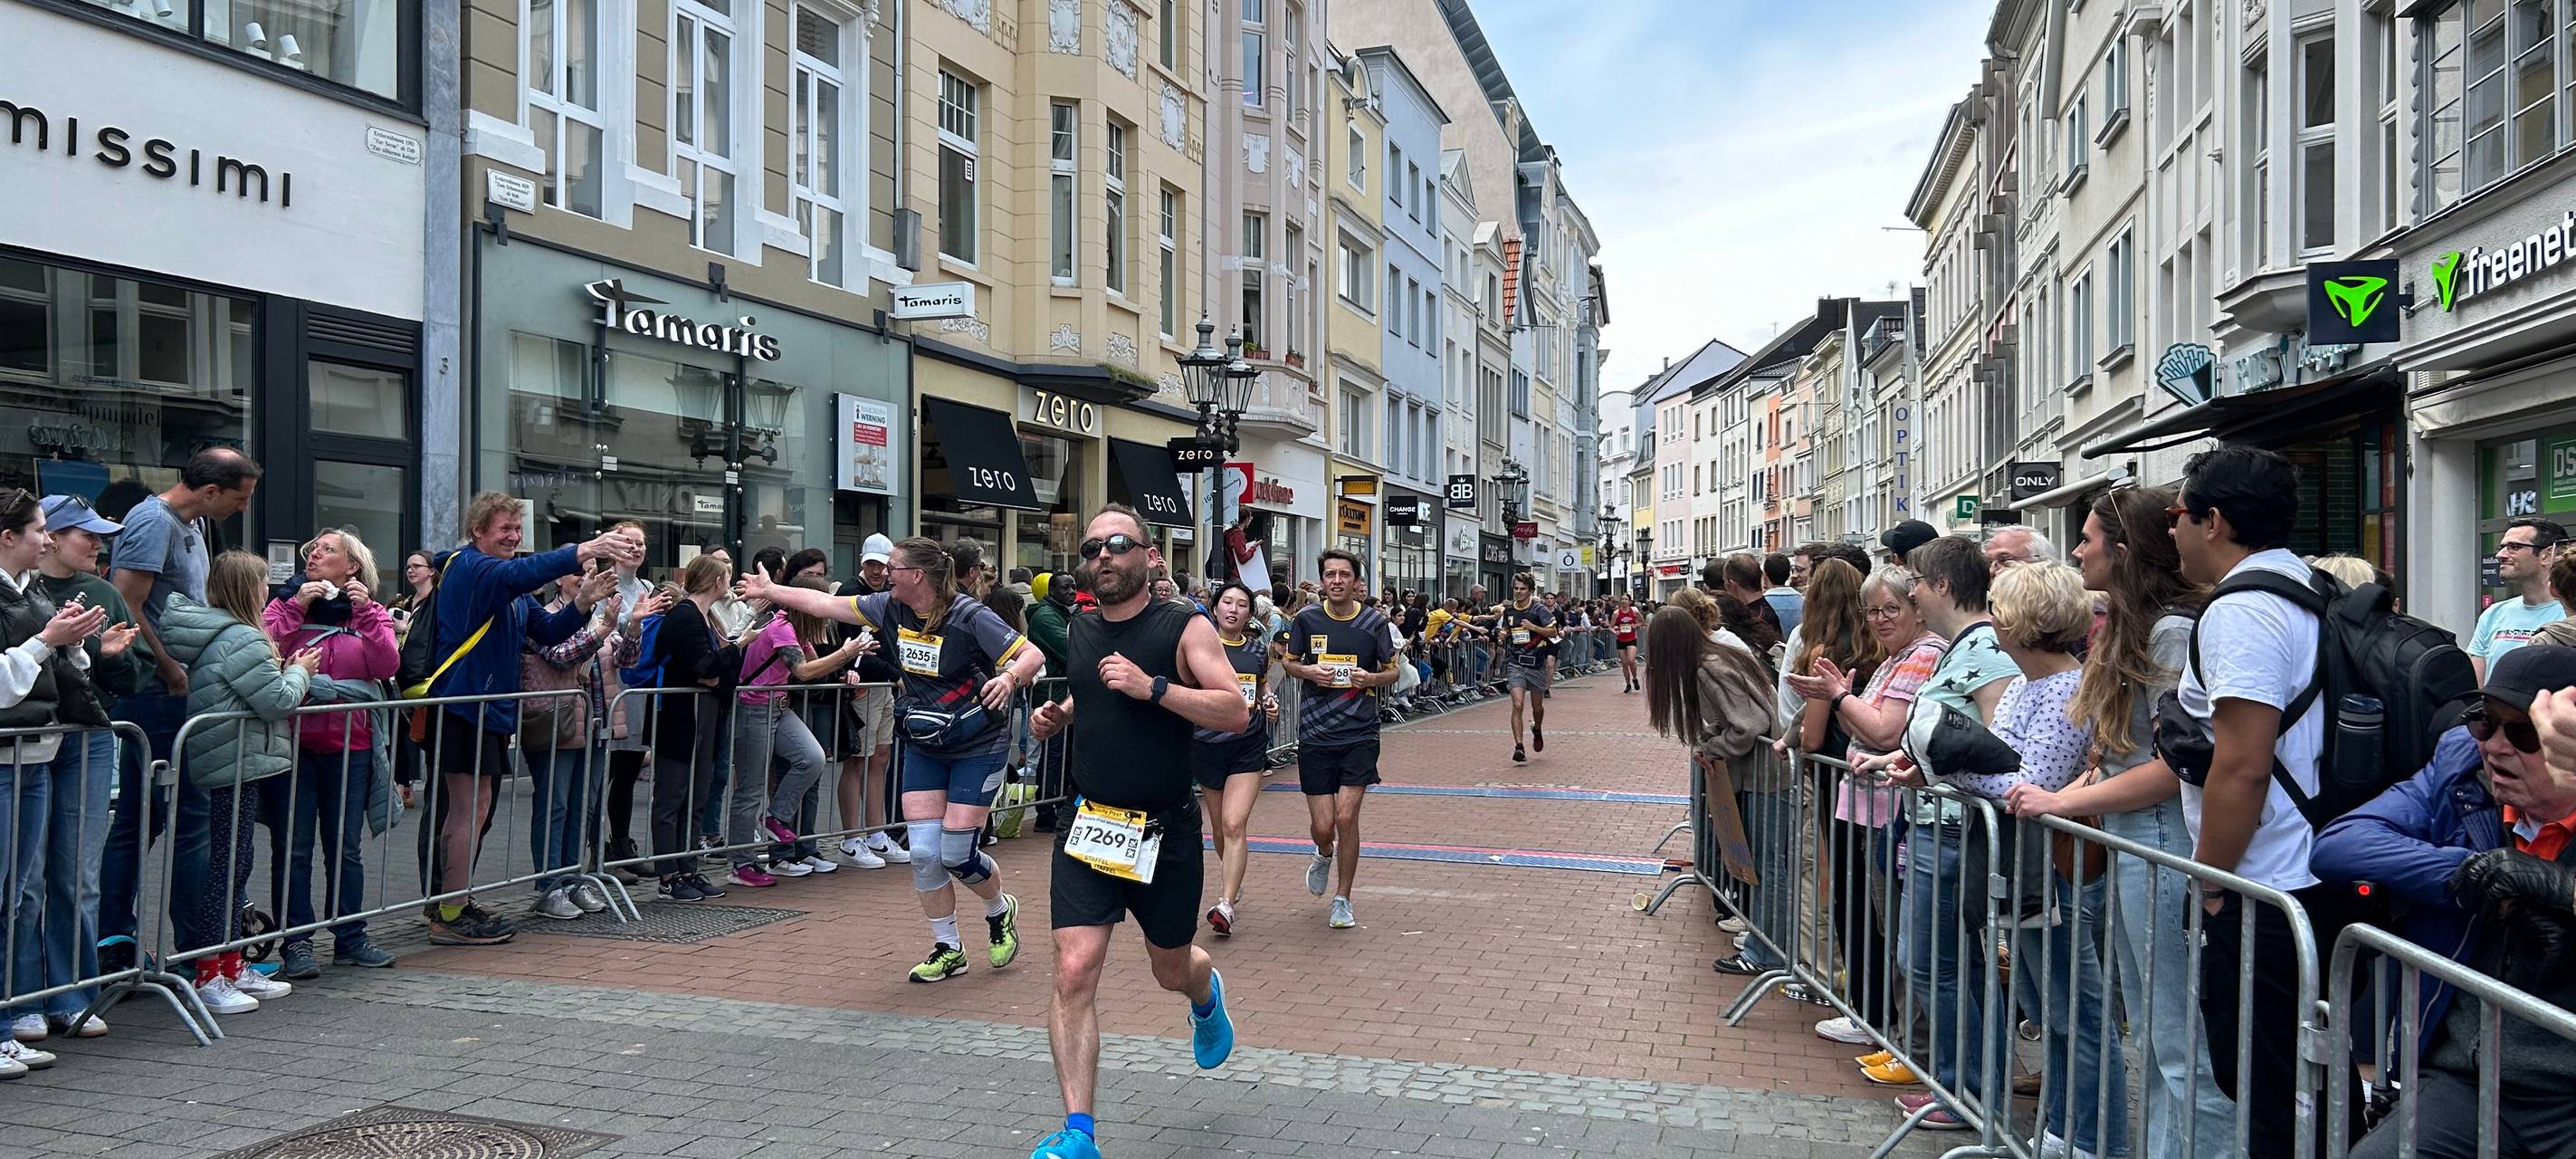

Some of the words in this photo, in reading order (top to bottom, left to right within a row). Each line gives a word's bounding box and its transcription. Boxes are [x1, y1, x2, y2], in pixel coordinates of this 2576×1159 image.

[2467, 210, 2576, 296] freenet
[898, 293, 962, 307] Tamaris
[585, 278, 782, 362] Tamaris
[861, 413, 886, 424] WERNING
[1034, 390, 1094, 433] zero
[1178, 450, 1213, 460] zero
[1895, 407, 1909, 512] OPTIK
[968, 466, 1016, 492] zero
[2015, 476, 2055, 486] ONLY
[1143, 493, 1177, 514] zero
[906, 648, 930, 662] 2635
[1083, 825, 1126, 848] 7269
[1084, 855, 1108, 866] STAFFEL
